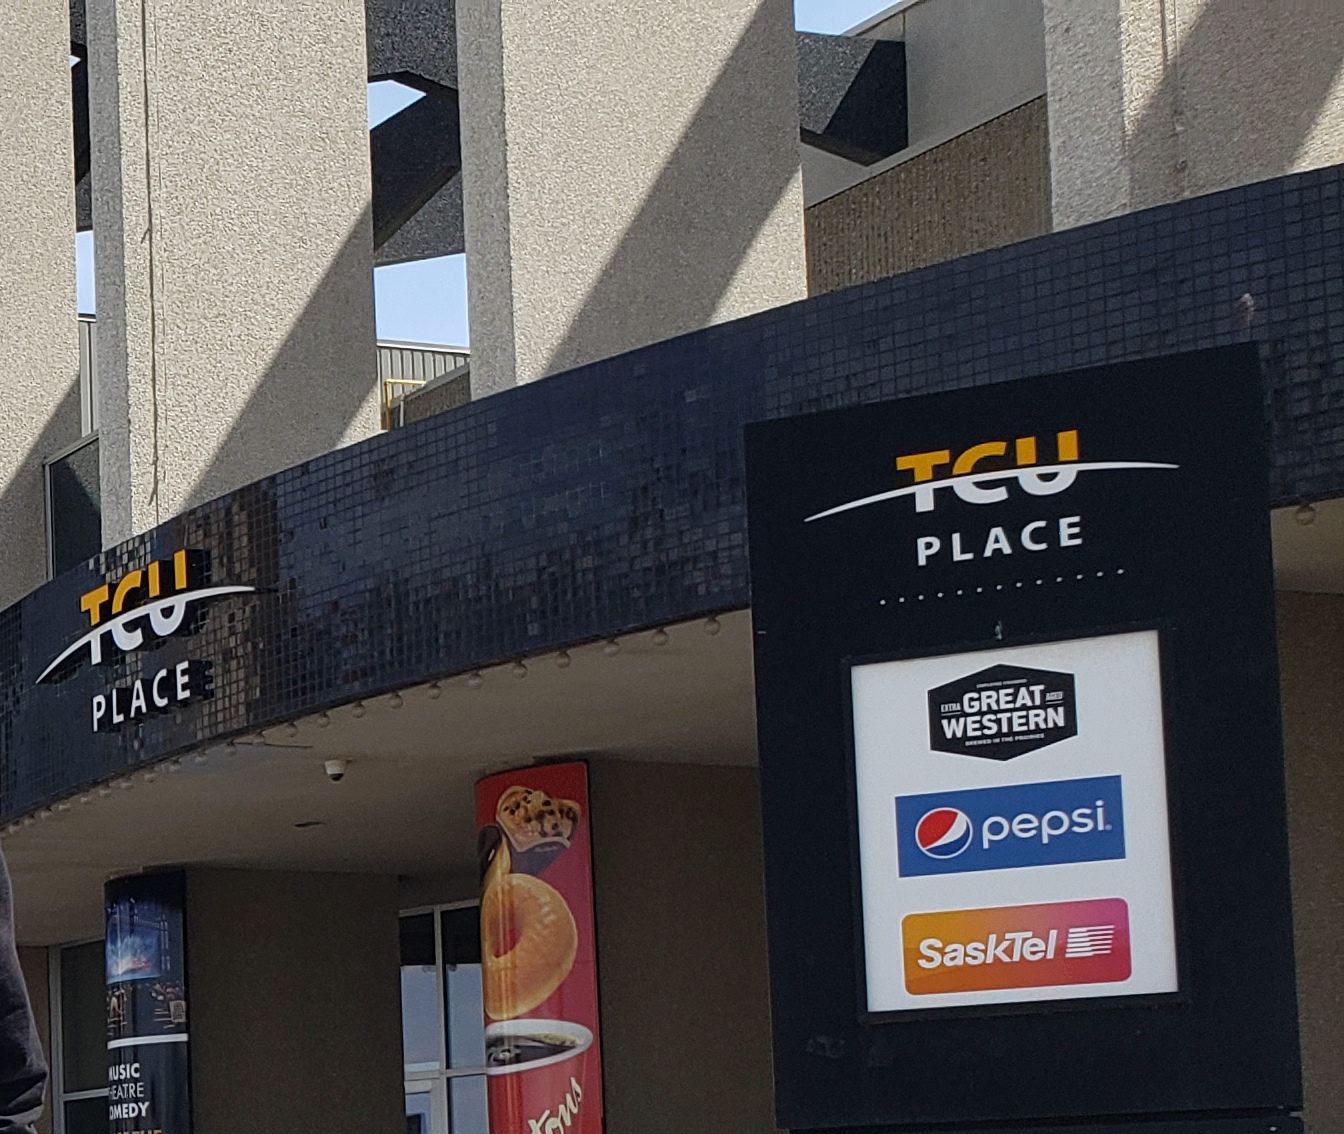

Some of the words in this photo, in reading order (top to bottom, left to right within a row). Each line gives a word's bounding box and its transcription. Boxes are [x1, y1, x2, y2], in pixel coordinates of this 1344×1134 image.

[896, 430, 1078, 512] TCU
[916, 515, 1083, 566] PLACE
[80, 549, 187, 666] TCU
[92, 660, 190, 732] PLACE
[940, 702, 961, 713] EXTRA
[962, 684, 1045, 714] GREAT
[940, 706, 1065, 739] WESTERN
[982, 799, 1105, 849] pepsi
[917, 929, 1058, 969] SaskTel
